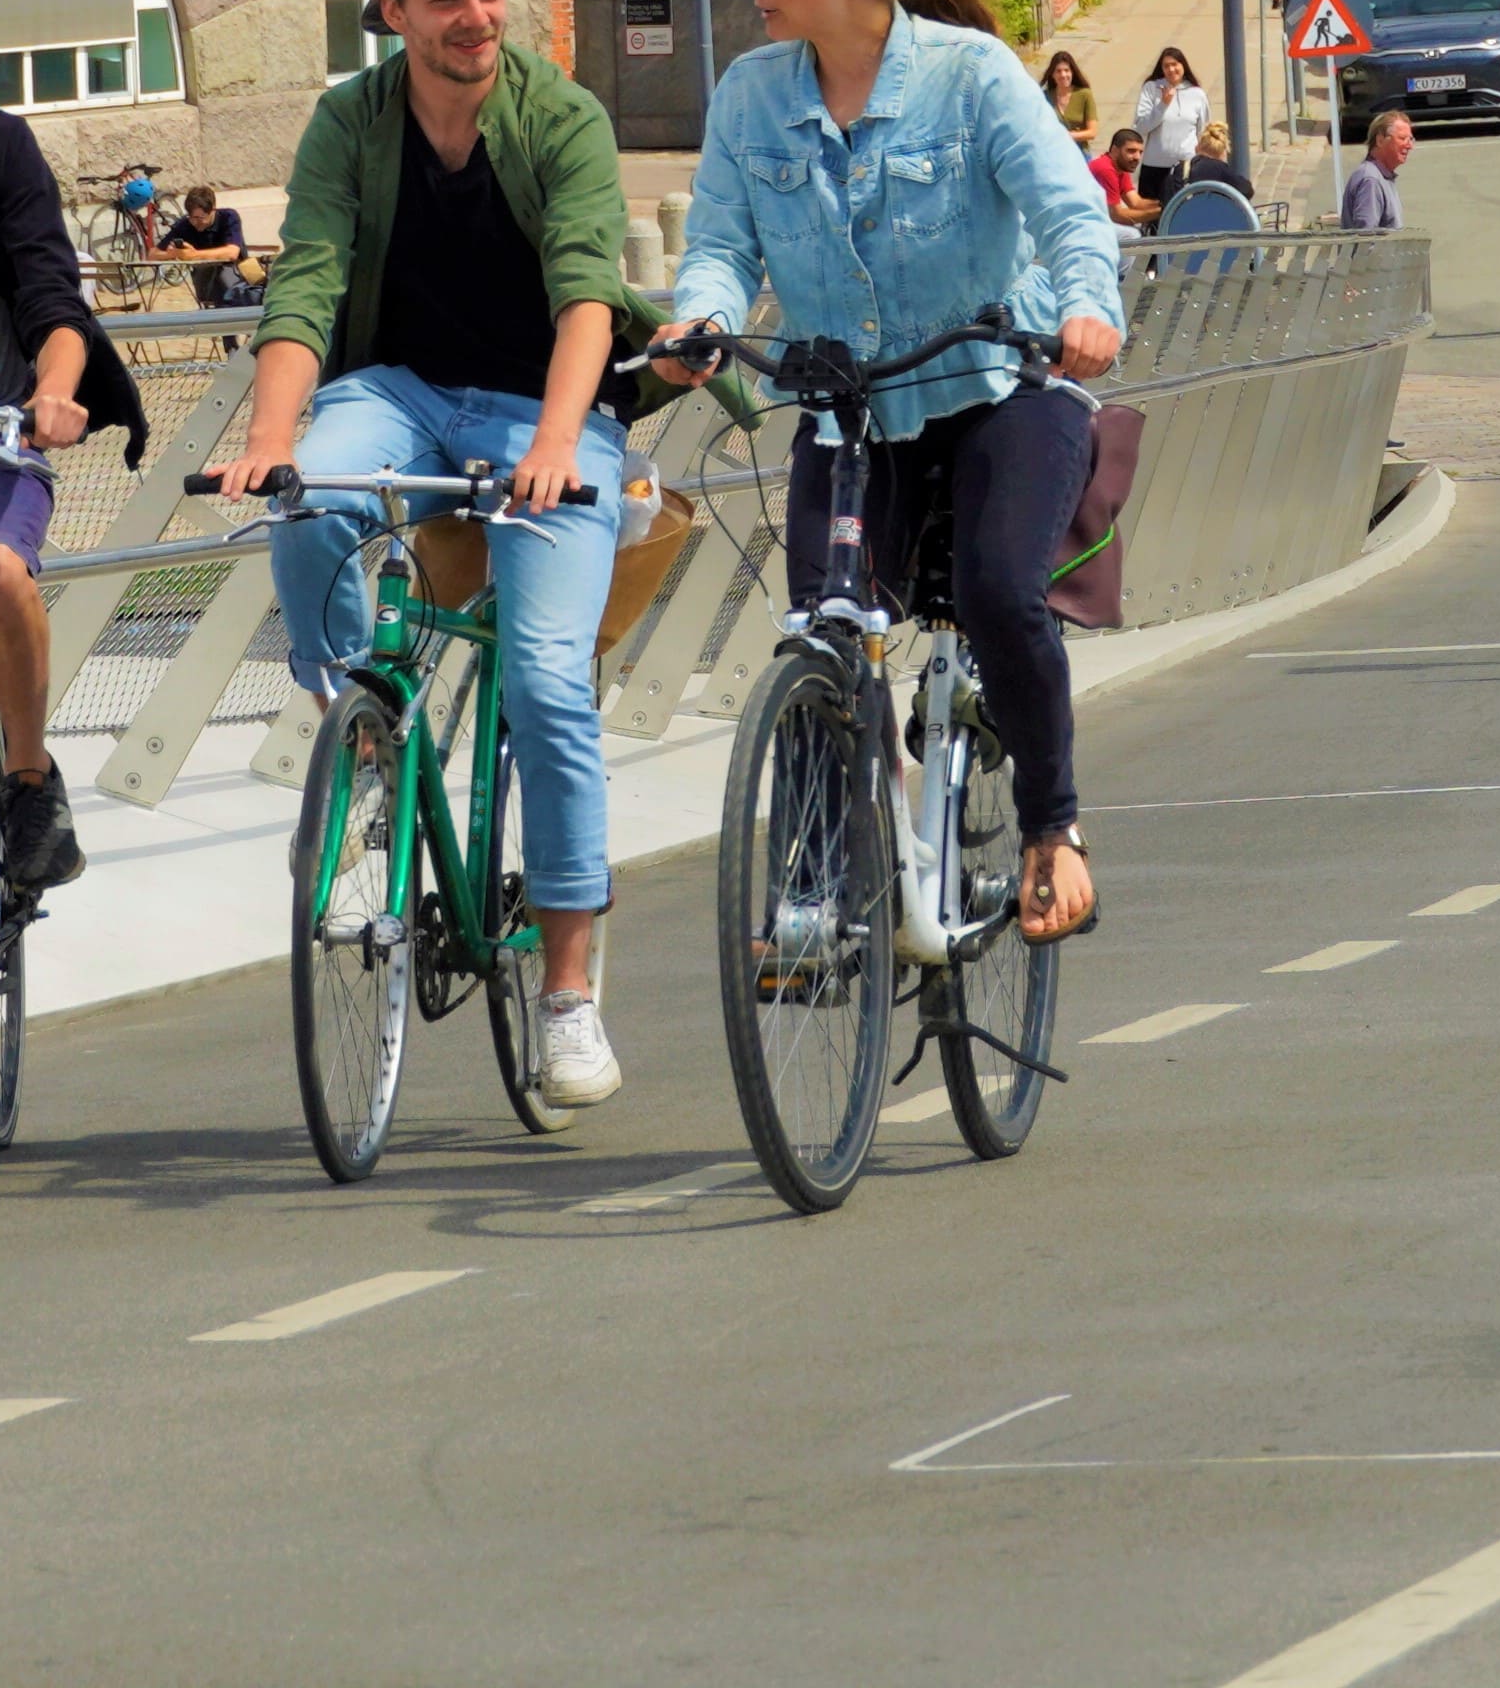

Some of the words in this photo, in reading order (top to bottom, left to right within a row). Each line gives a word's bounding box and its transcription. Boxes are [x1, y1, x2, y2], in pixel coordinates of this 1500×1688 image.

[1415, 79, 1429, 90] CU
[1431, 78, 1442, 89] 72
[1444, 76, 1464, 88] 356
